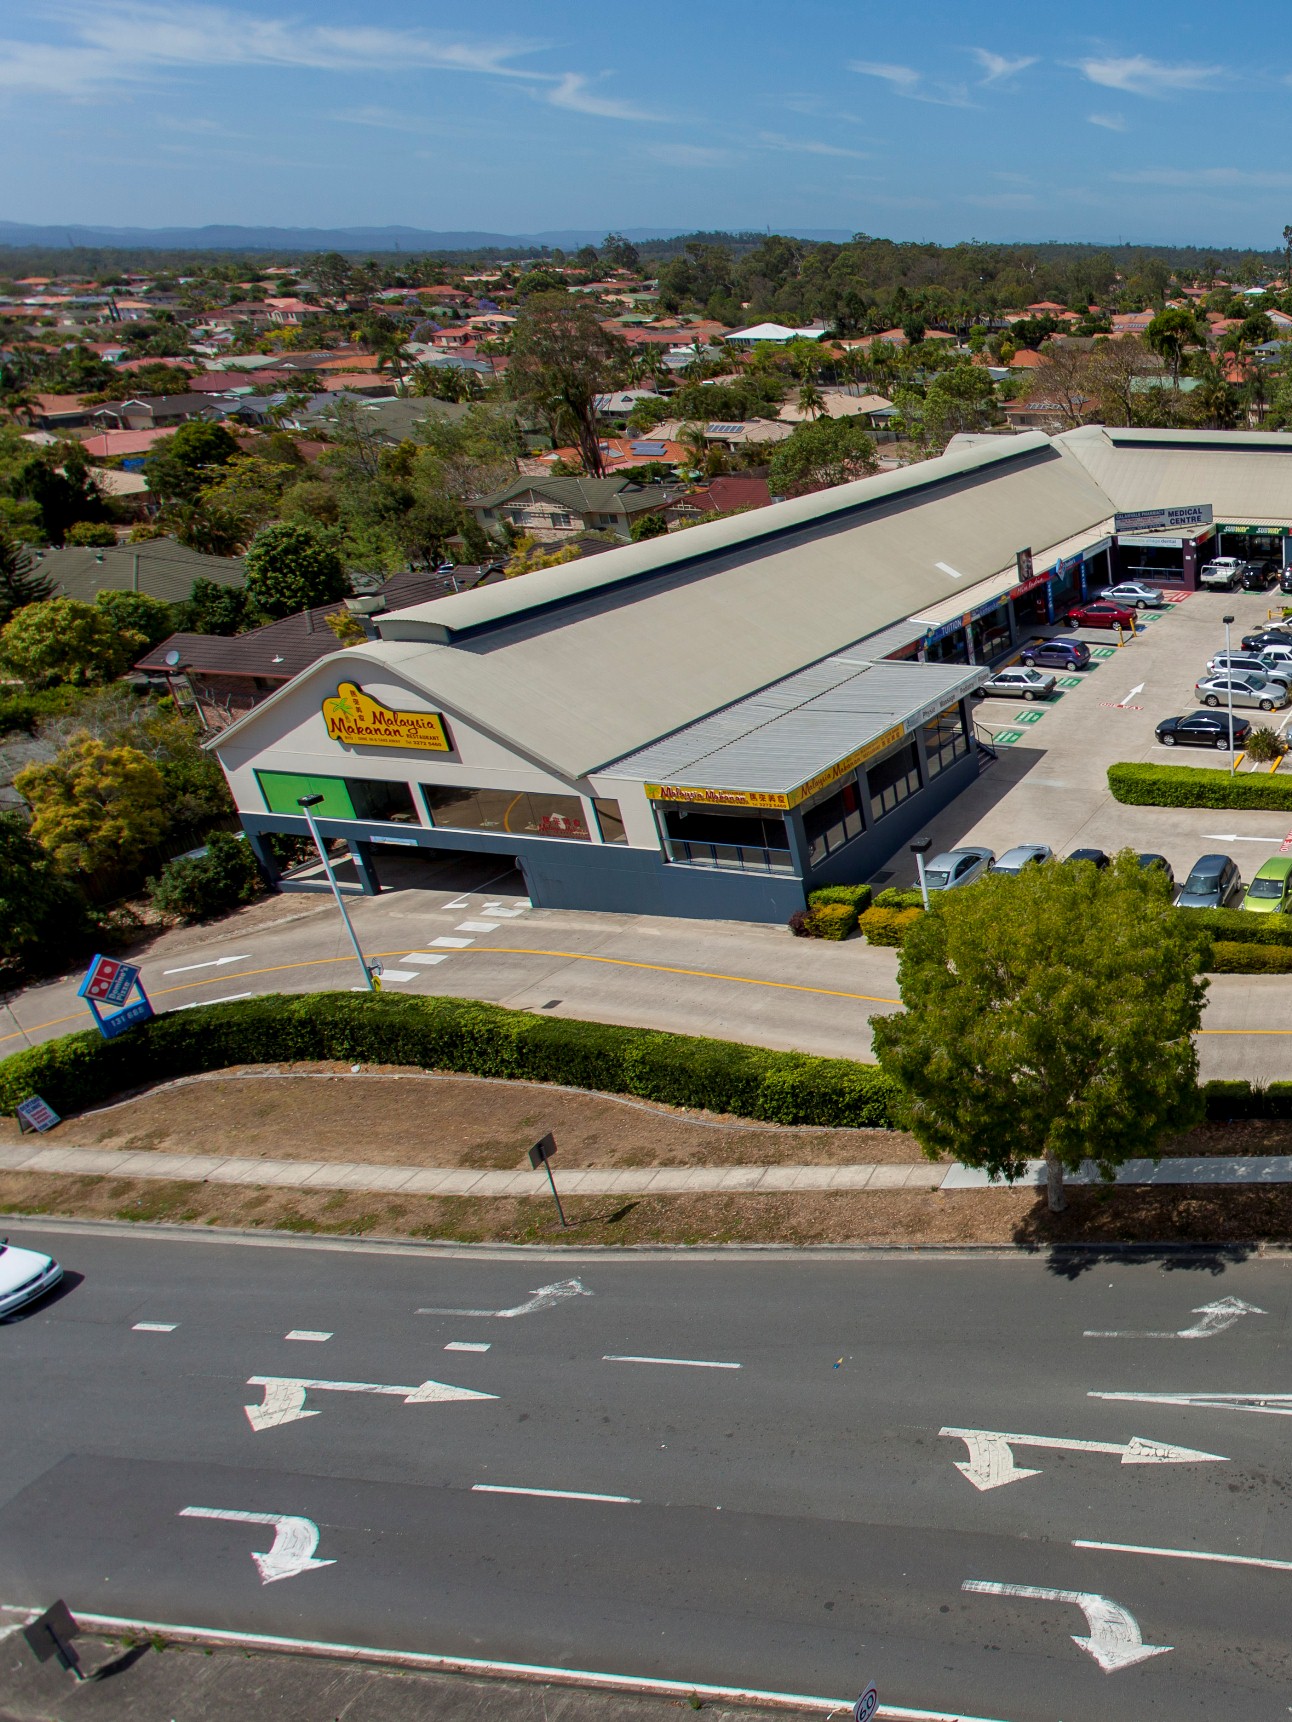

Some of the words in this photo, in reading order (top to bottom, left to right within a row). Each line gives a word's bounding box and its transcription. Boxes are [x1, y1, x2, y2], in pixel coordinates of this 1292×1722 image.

[1168, 508, 1202, 517] MEDICAL
[1170, 515, 1202, 525] CENTRE
[941, 619, 962, 636] TUITION
[330, 717, 404, 737] Makanan
[372, 711, 436, 735] Malaysia
[801, 773, 831, 799] Malaysia
[832, 758, 861, 779] Makanan
[660, 786, 703, 800] Malaysia
[705, 789, 747, 801] Makanan
[108, 967, 129, 999] Domino's
[116, 981, 130, 1001] Pizza
[110, 1016, 126, 1027] 131
[860, 1694, 874, 1721] 60
